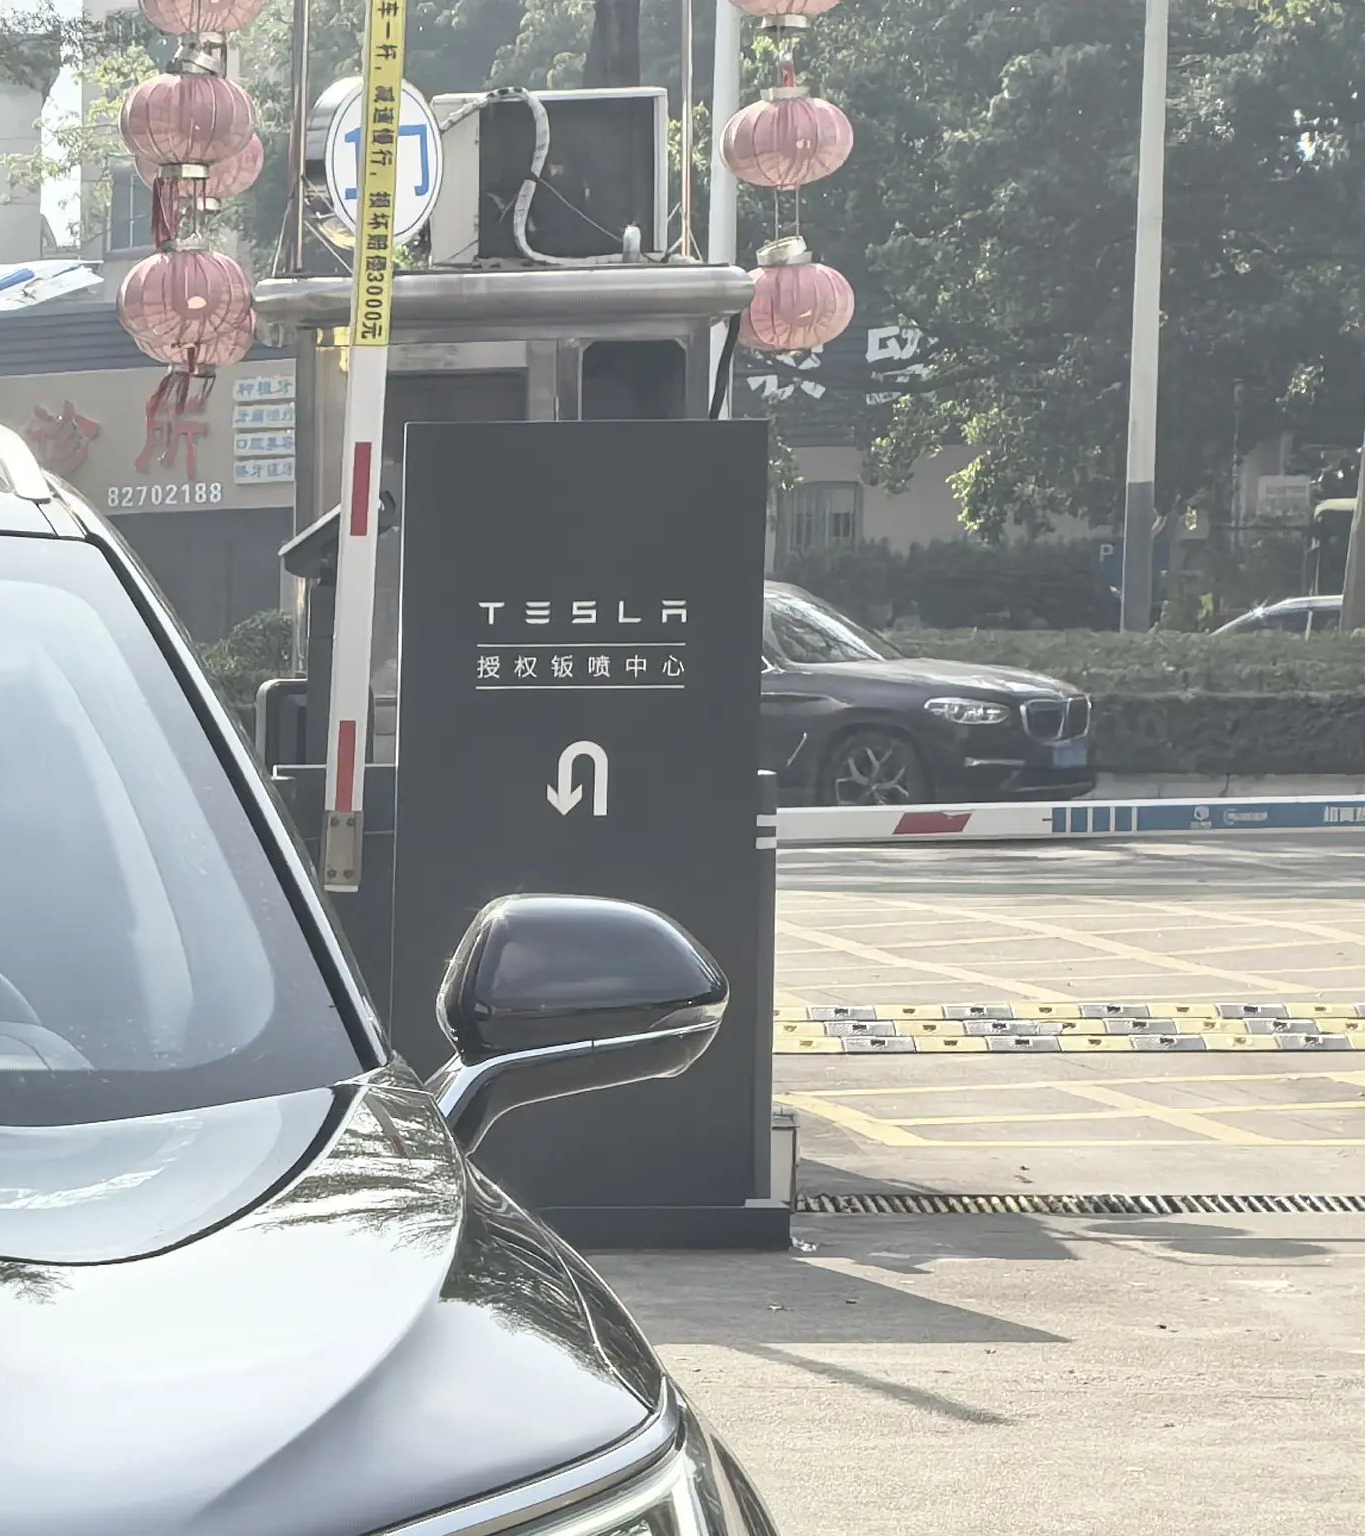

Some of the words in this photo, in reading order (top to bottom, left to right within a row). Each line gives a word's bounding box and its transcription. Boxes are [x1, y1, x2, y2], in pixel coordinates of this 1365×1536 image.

[107, 482, 222, 508] 82702188
[478, 599, 688, 625] TESLA
[476, 653, 686, 680] 授权钣喷中心
